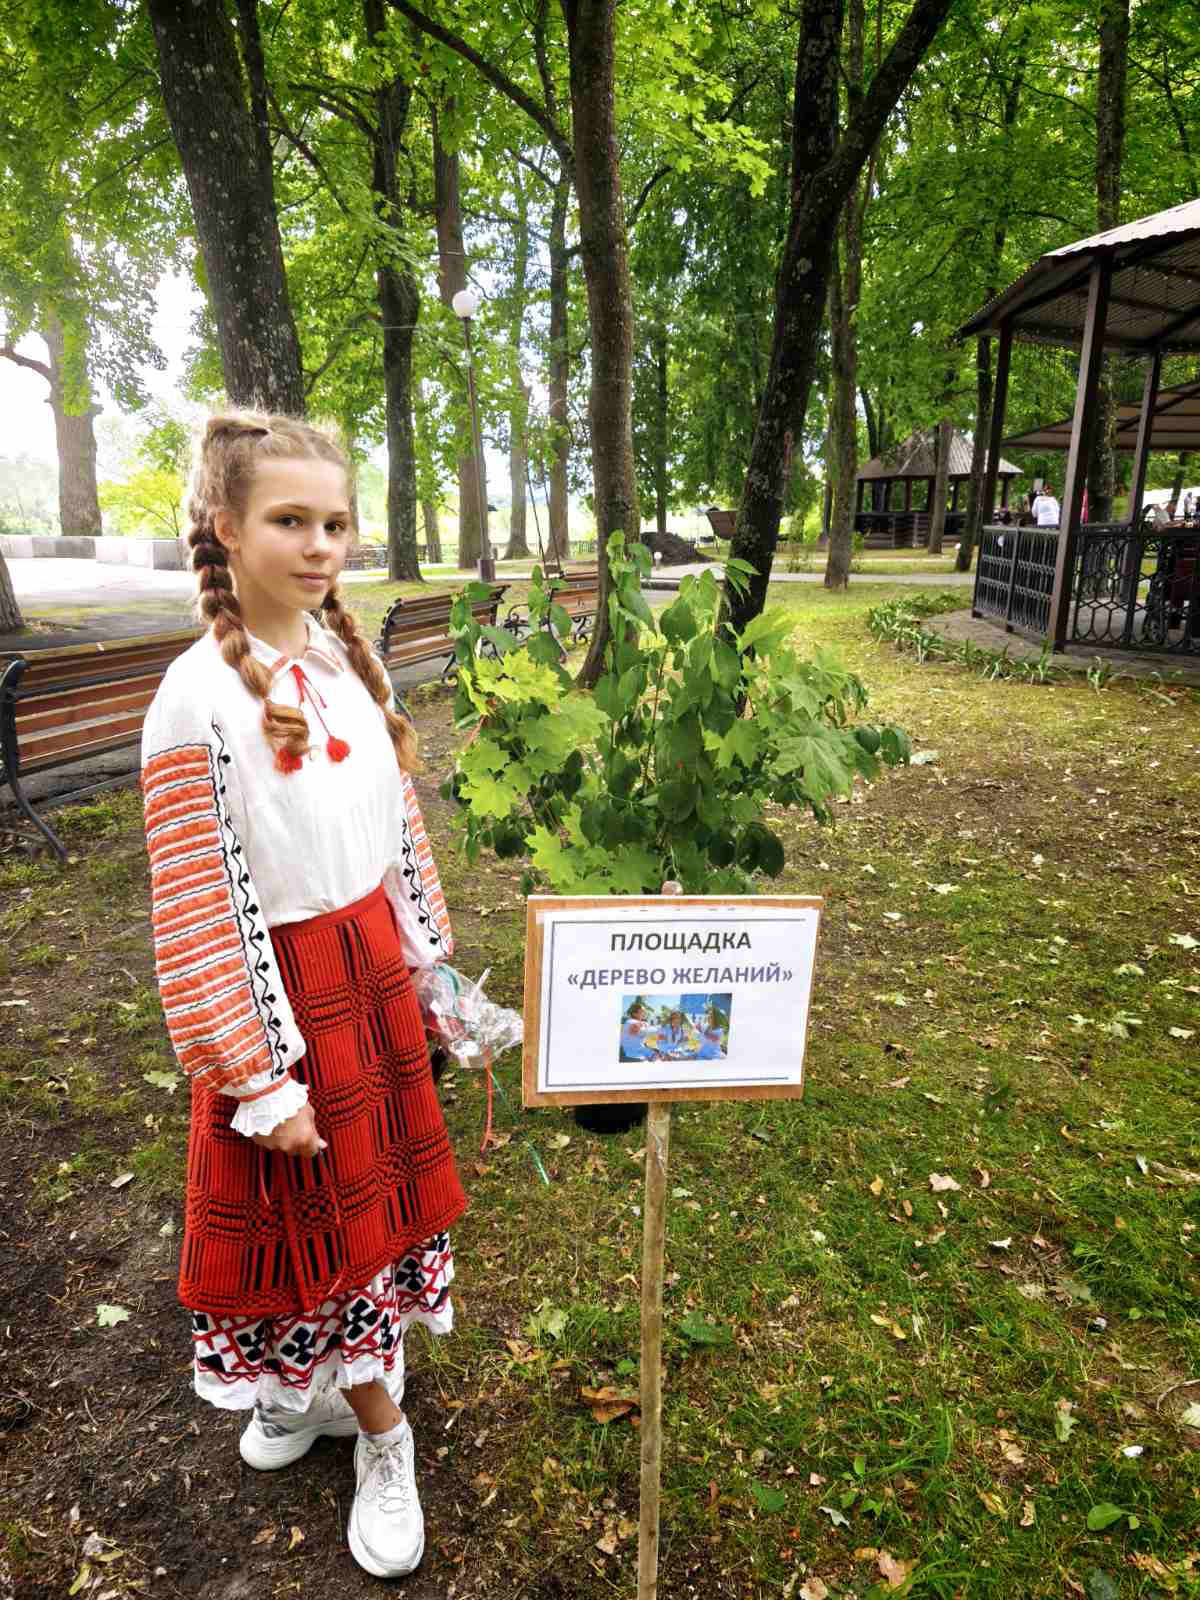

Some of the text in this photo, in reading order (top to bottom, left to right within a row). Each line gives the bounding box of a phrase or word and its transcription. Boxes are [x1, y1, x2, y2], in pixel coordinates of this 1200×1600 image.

[610, 931, 752, 954] ПЛОЩАДКА
[567, 962, 793, 990] «ДЕРЕВО ЖЕЛАНИЙ»
